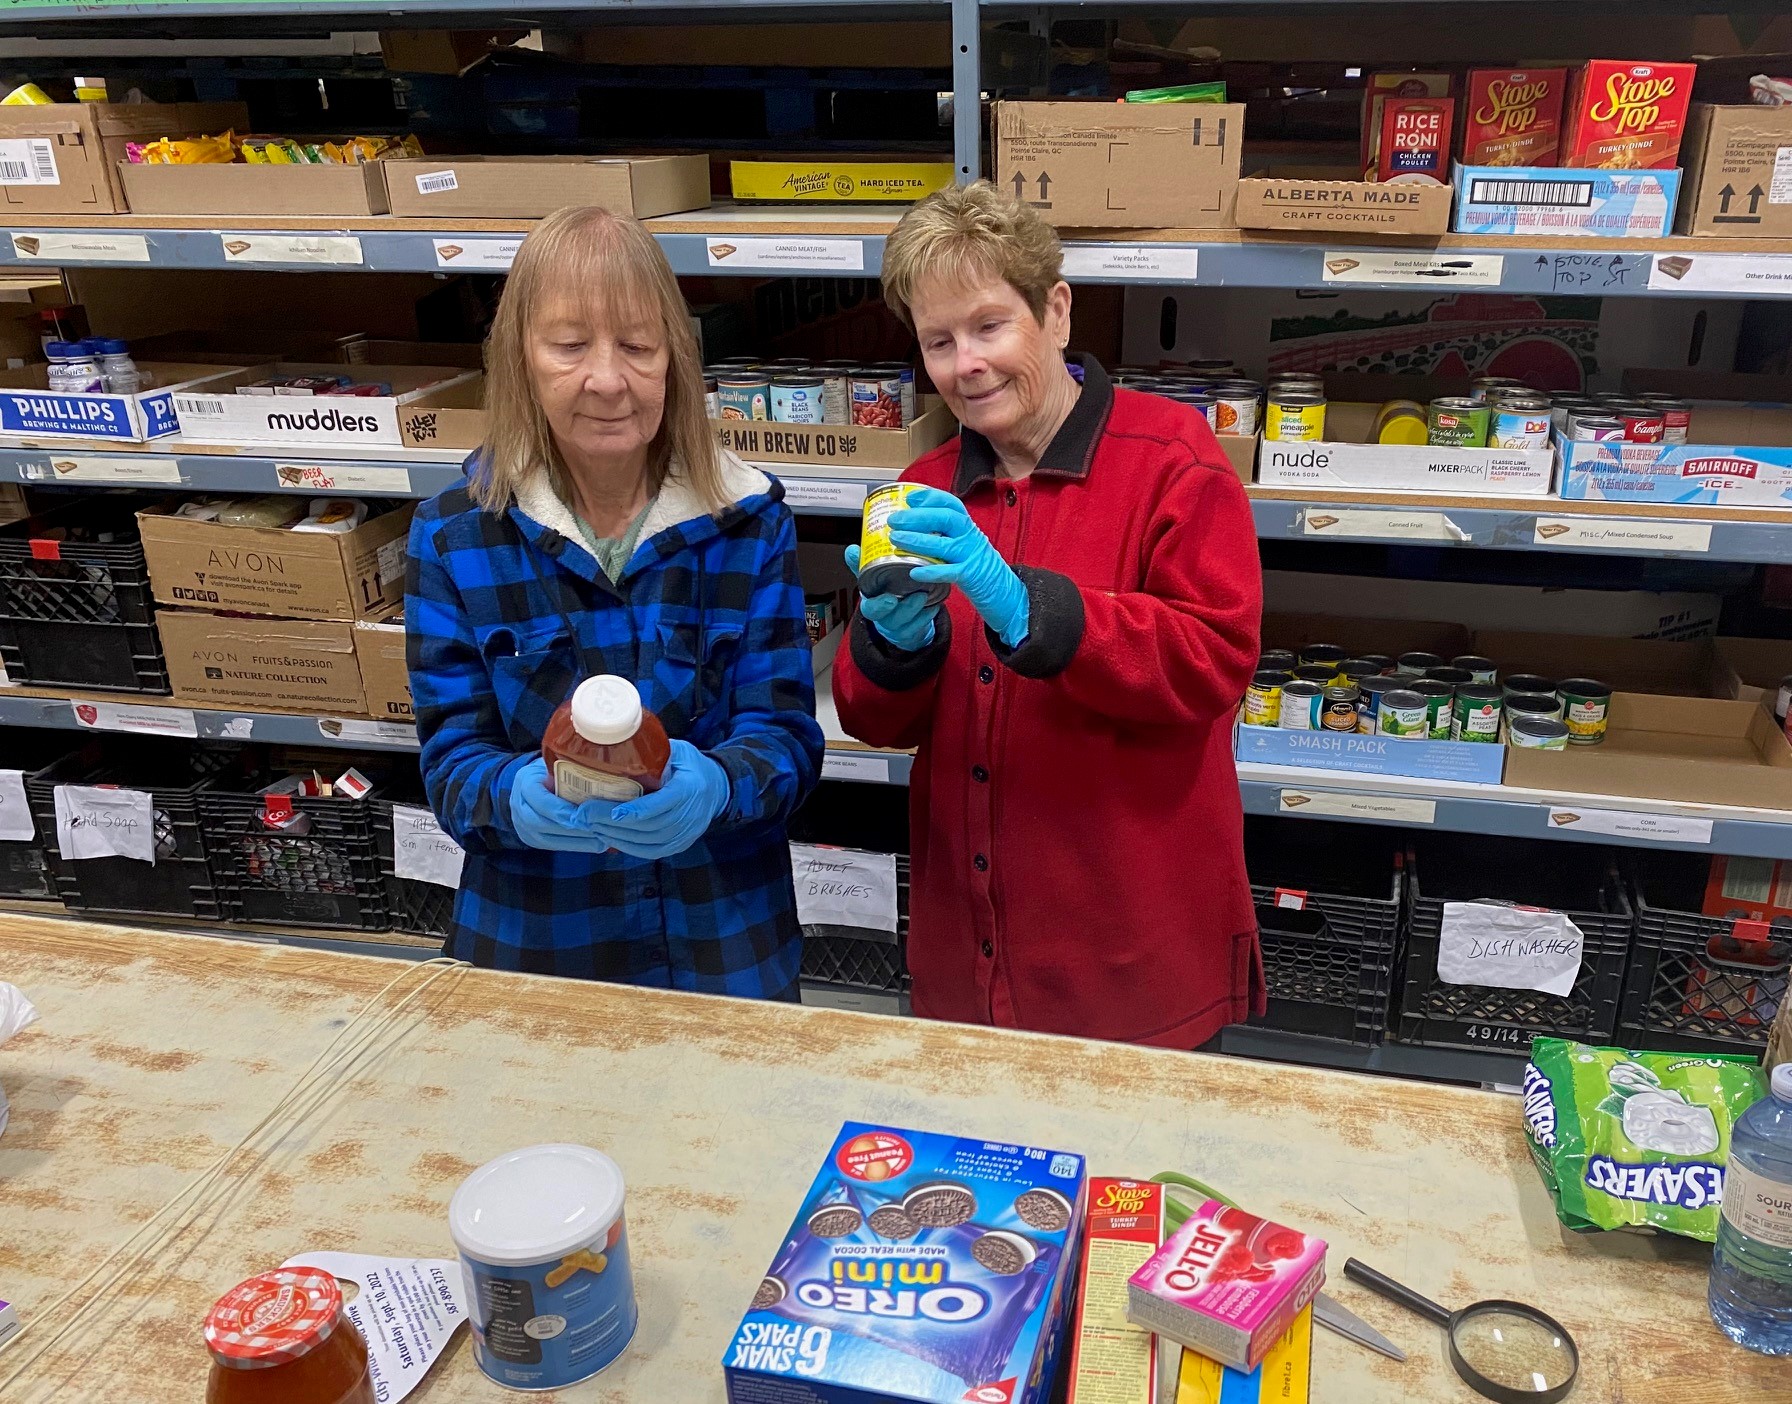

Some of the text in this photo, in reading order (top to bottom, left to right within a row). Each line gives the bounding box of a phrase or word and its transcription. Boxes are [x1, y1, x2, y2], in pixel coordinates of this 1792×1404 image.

[1475, 80, 1550, 125] Stove
[1590, 72, 1676, 122] Stove
[1396, 114, 1440, 130] RICE
[1498, 106, 1537, 135] Top
[1615, 104, 1660, 135] Top
[1072, 132, 1096, 140] Canada
[1031, 147, 1050, 156] Claire,
[781, 170, 832, 189] American
[794, 181, 827, 193] VINTAGE
[836, 181, 852, 191] TEA
[860, 179, 904, 187] HARD ICED
[1262, 188, 1421, 205] ALBERTA MADE
[1282, 211, 1396, 223] CRAFT COCKTAILS
[1113, 254, 1133, 263] Variety
[1745, 272, 1783, 281] Other Drink
[11, 397, 115, 422] PHILLIPS
[22, 420, 107, 432] BREWING MALTING
[267, 408, 379, 433] muddlers
[405, 413, 438, 434] ALLEY
[1280, 423, 1315, 432] pineapple
[1525, 420, 1548, 432] Dole
[412, 427, 438, 443] KAT
[734, 430, 837, 457] MH BREW CO
[1503, 439, 1531, 449] Gold
[1272, 449, 1329, 468] nude
[302, 467, 323, 481] BEER
[1687, 461, 1754, 476] SMIRNOFF
[312, 477, 337, 489] FLAT
[800, 486, 842, 495] BEANS/LEGUMES
[1704, 479, 1735, 490] ICE
[1388, 521, 1410, 529] Canned
[1626, 532, 1659, 540] Condensed
[1659, 533, 1674, 541] Soup
[207, 549, 285, 575] AVON
[209, 573, 303, 590] download the Avon Spark app
[224, 581, 265, 593] avonspark.ca
[265, 585, 274, 593] for
[275, 586, 299, 596] details
[223, 597, 270, 609] myavoncanada
[192, 650, 238, 663] AVON
[225, 669, 328, 685] NATURE COLLECTION
[181, 685, 358, 705] avon.ca fruits-passion.com ca.naturecollection.com
[1401, 711, 1422, 719] Green
[1288, 735, 1387, 755] SMASH PACK
[1334, 760, 1352, 768] CRAFT
[1353, 762, 1383, 770] COCKTAILS
[1351, 803, 1396, 812] Mixed Vegetables
[102, 811, 139, 835] Soap
[429, 840, 460, 855] items
[807, 859, 854, 873] ADULT
[808, 880, 873, 899] BRUSHES
[1467, 937, 1581, 959] DISH WASHER
[847, 1147, 904, 1164] Peanut Free
[1588, 1159, 1723, 1209] ESAVERS
[1097, 1184, 1153, 1209] Stove
[1756, 1193, 1792, 1211] SOUR
[1116, 1198, 1145, 1215] Top
[1109, 1216, 1139, 1224] TURKEY
[1110, 1221, 1137, 1229] DINDE
[834, 1245, 946, 1256] MADE WITH REAL COCOA
[833, 1259, 943, 1288] mini
[798, 1284, 985, 1322] OREO
[1226, 1287, 1261, 1321] raspberry
[365, 1271, 414, 1370] Saturday, Sept. 2022
[739, 1322, 803, 1346] PAKS
[418, 1347, 428, 1363] Please
[796, 1324, 832, 1375] 6
[731, 1344, 792, 1373] SNAK
